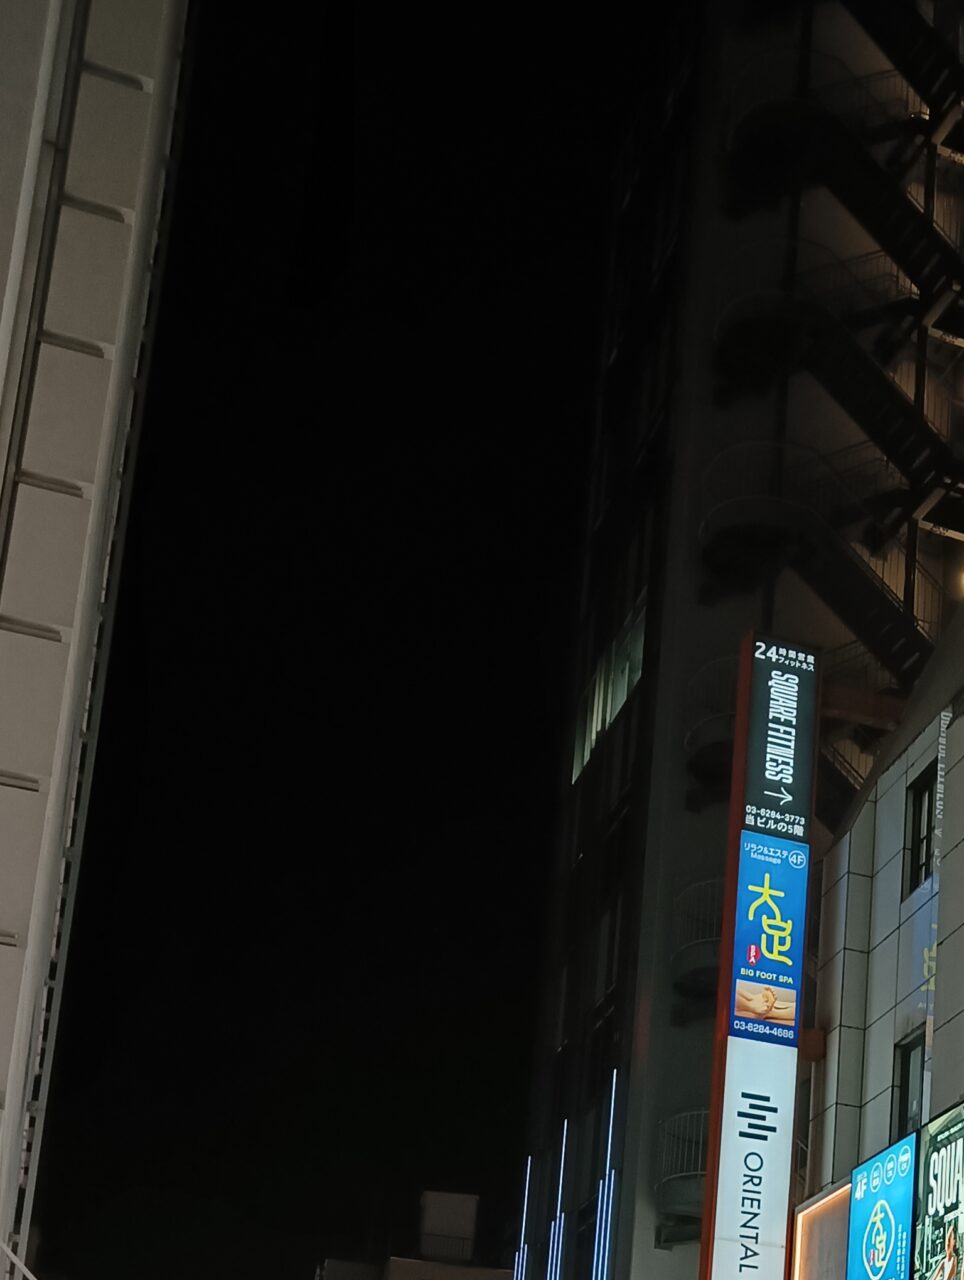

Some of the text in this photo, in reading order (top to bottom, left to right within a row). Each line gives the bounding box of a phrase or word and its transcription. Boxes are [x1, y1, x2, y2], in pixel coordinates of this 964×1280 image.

[765, 670, 799, 784] SQUARE FITNESS
[745, 804, 805, 825] 03-6284-3773
[745, 814, 804, 837] 当ビルの5階
[789, 853, 805, 866] 4F
[740, 967, 794, 985] BIG FOOT SPA
[854, 1178, 868, 1200] 4F
[737, 1152, 764, 1274] ORIENTAL
